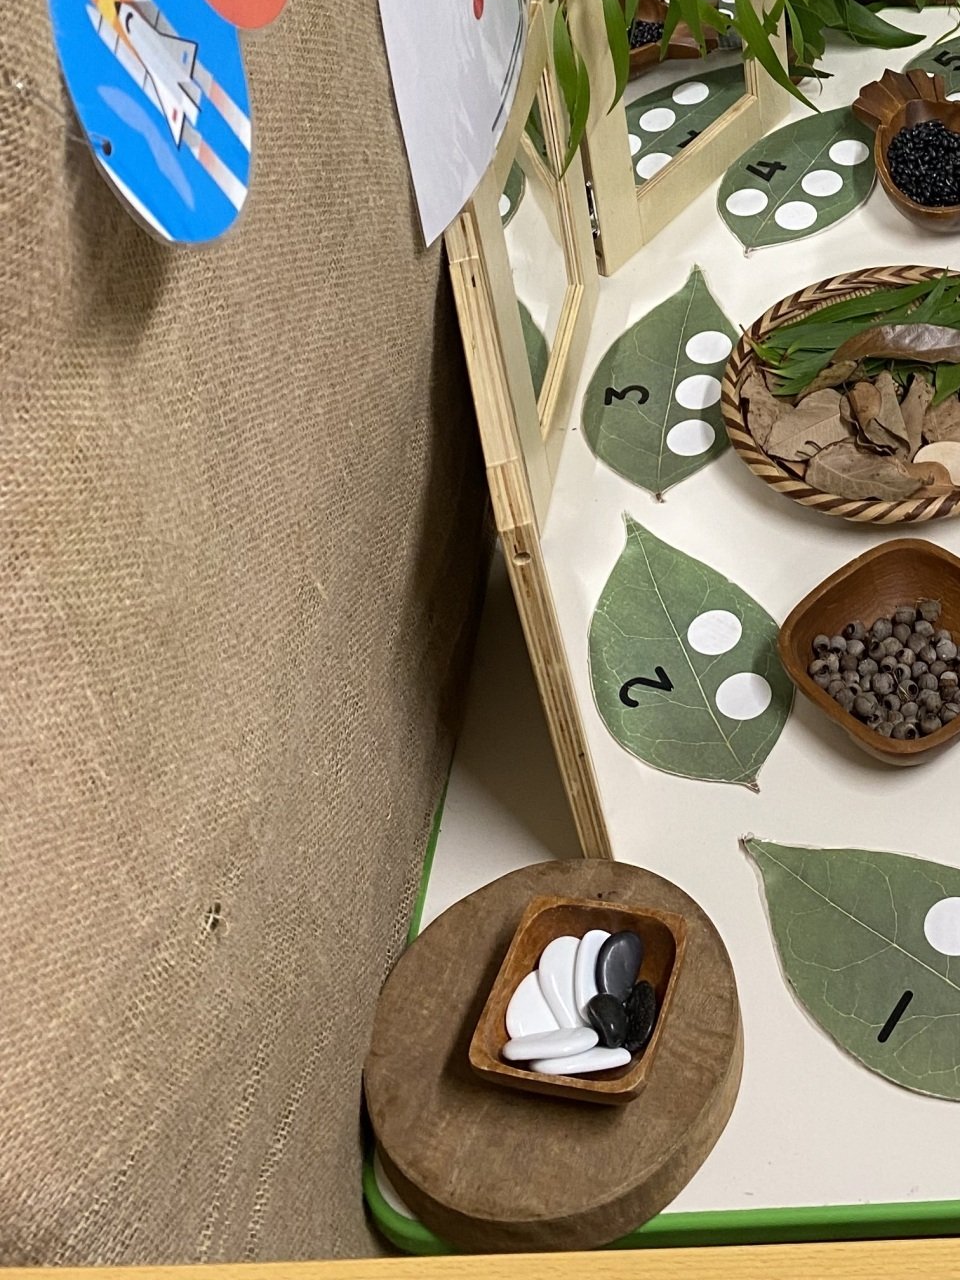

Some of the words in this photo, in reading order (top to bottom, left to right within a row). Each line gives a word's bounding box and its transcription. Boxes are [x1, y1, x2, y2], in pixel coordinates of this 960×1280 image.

[746, 159, 787, 182] 4
[604, 385, 649, 406] 3
[619, 665, 674, 708] 2
